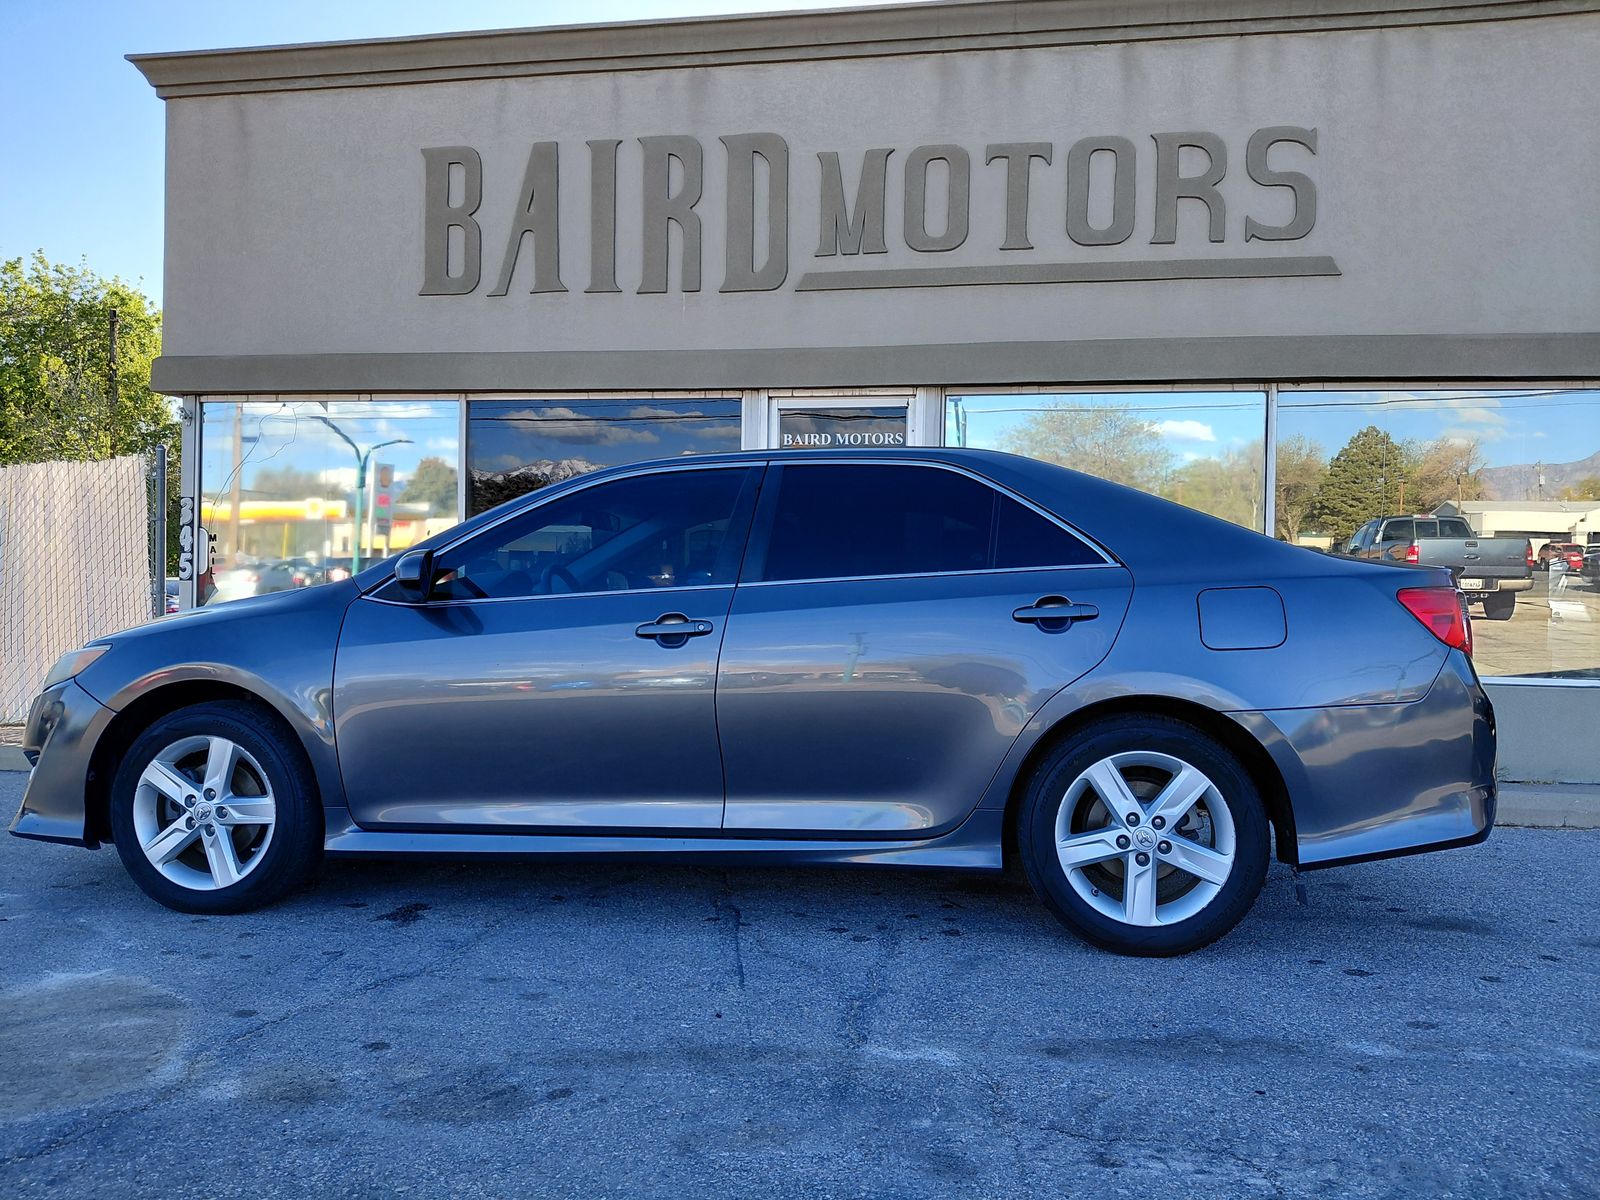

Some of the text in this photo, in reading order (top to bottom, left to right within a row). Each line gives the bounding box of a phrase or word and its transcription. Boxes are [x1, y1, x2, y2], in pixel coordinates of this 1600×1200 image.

[418, 126, 1318, 297] BAIRD MOTORS
[783, 432, 904, 446] BAIRD MOTORS
[179, 497, 193, 580] 345
[209, 533, 217, 575] MAIL
